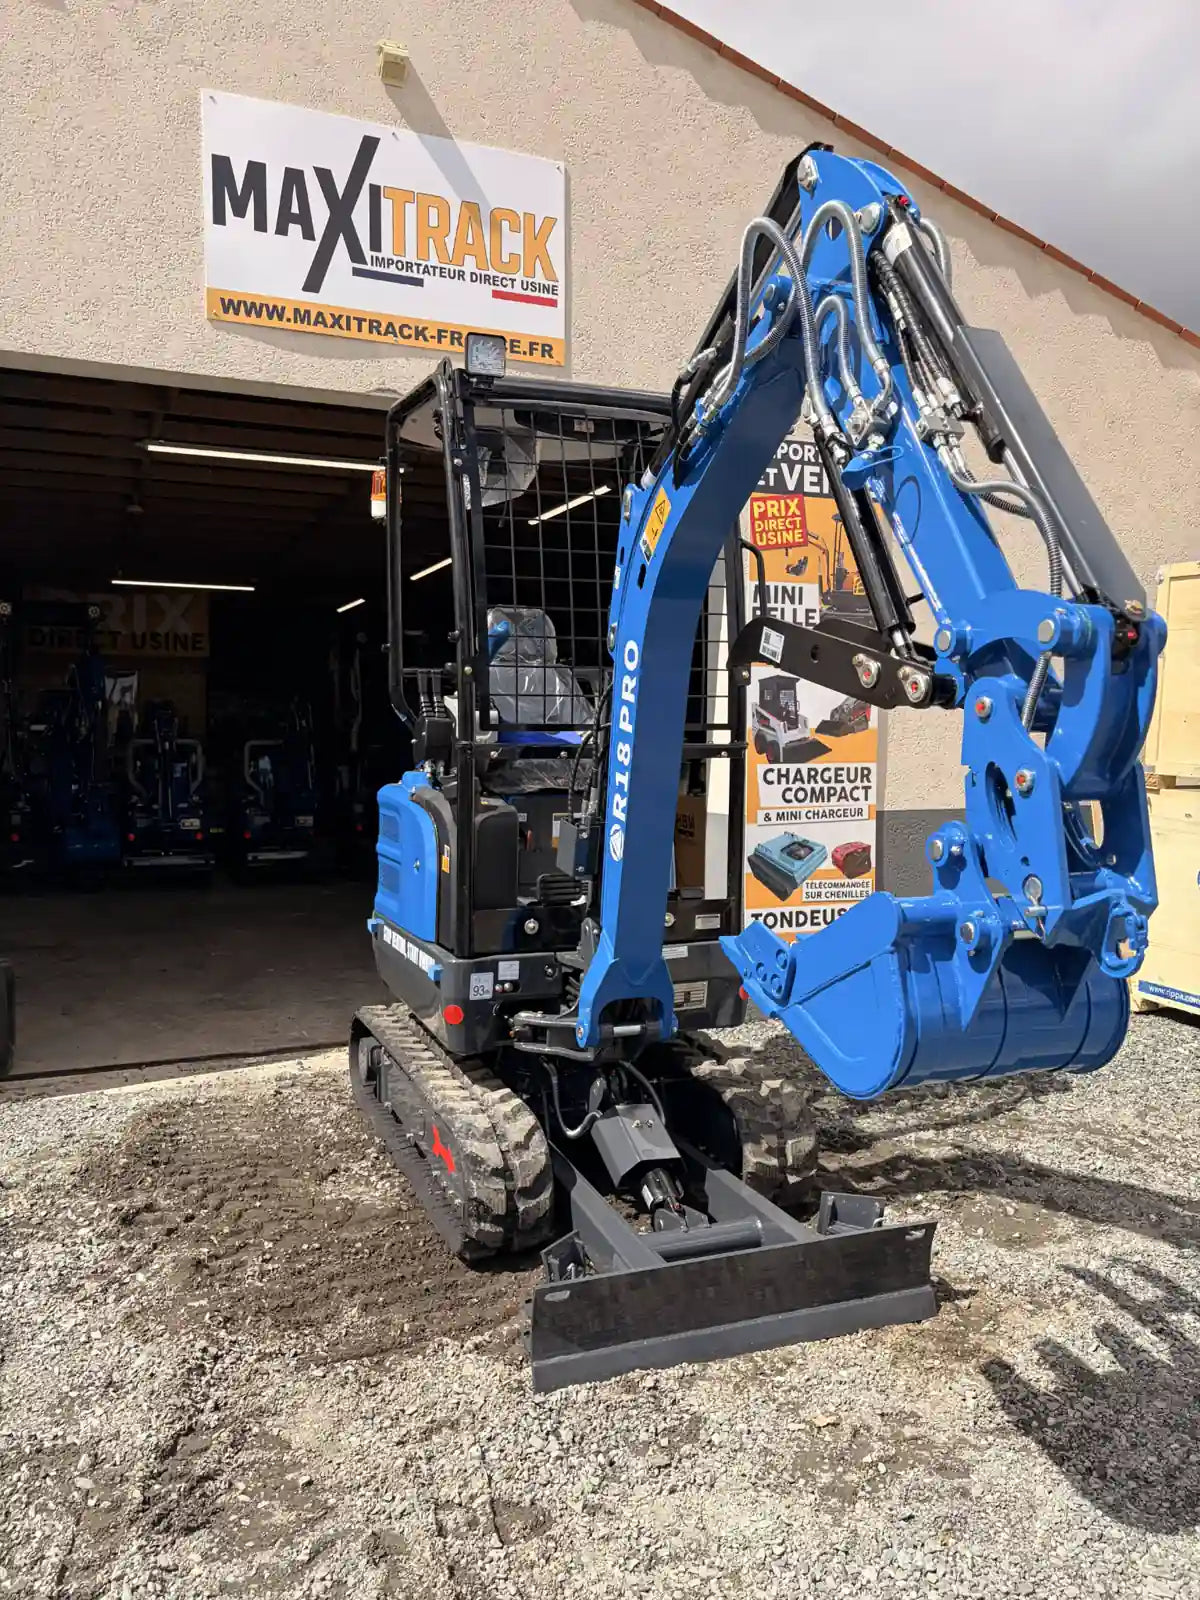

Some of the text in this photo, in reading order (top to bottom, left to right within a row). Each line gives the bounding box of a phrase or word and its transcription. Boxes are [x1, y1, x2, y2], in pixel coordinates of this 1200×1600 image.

[211, 135, 558, 293] MAXITRACK
[369, 254, 559, 296] IMPORTATEUR DIRECT USINE
[219, 295, 555, 360] WWW.MAXITRACK-FRE.FR
[772, 441, 823, 464] POR
[752, 497, 801, 519] PRIX
[755, 517, 802, 532] DIRECT
[755, 529, 804, 546] USINE
[131, 631, 205, 651] USINE
[612, 639, 640, 822] R18 PRO
[762, 766, 872, 786] CHARGEUR
[781, 785, 872, 804] COMPACT
[763, 807, 864, 822] & MINI CHARGEUR
[805, 889, 870, 900] SUR CHENILLES
[472, 984, 485, 997] 93
